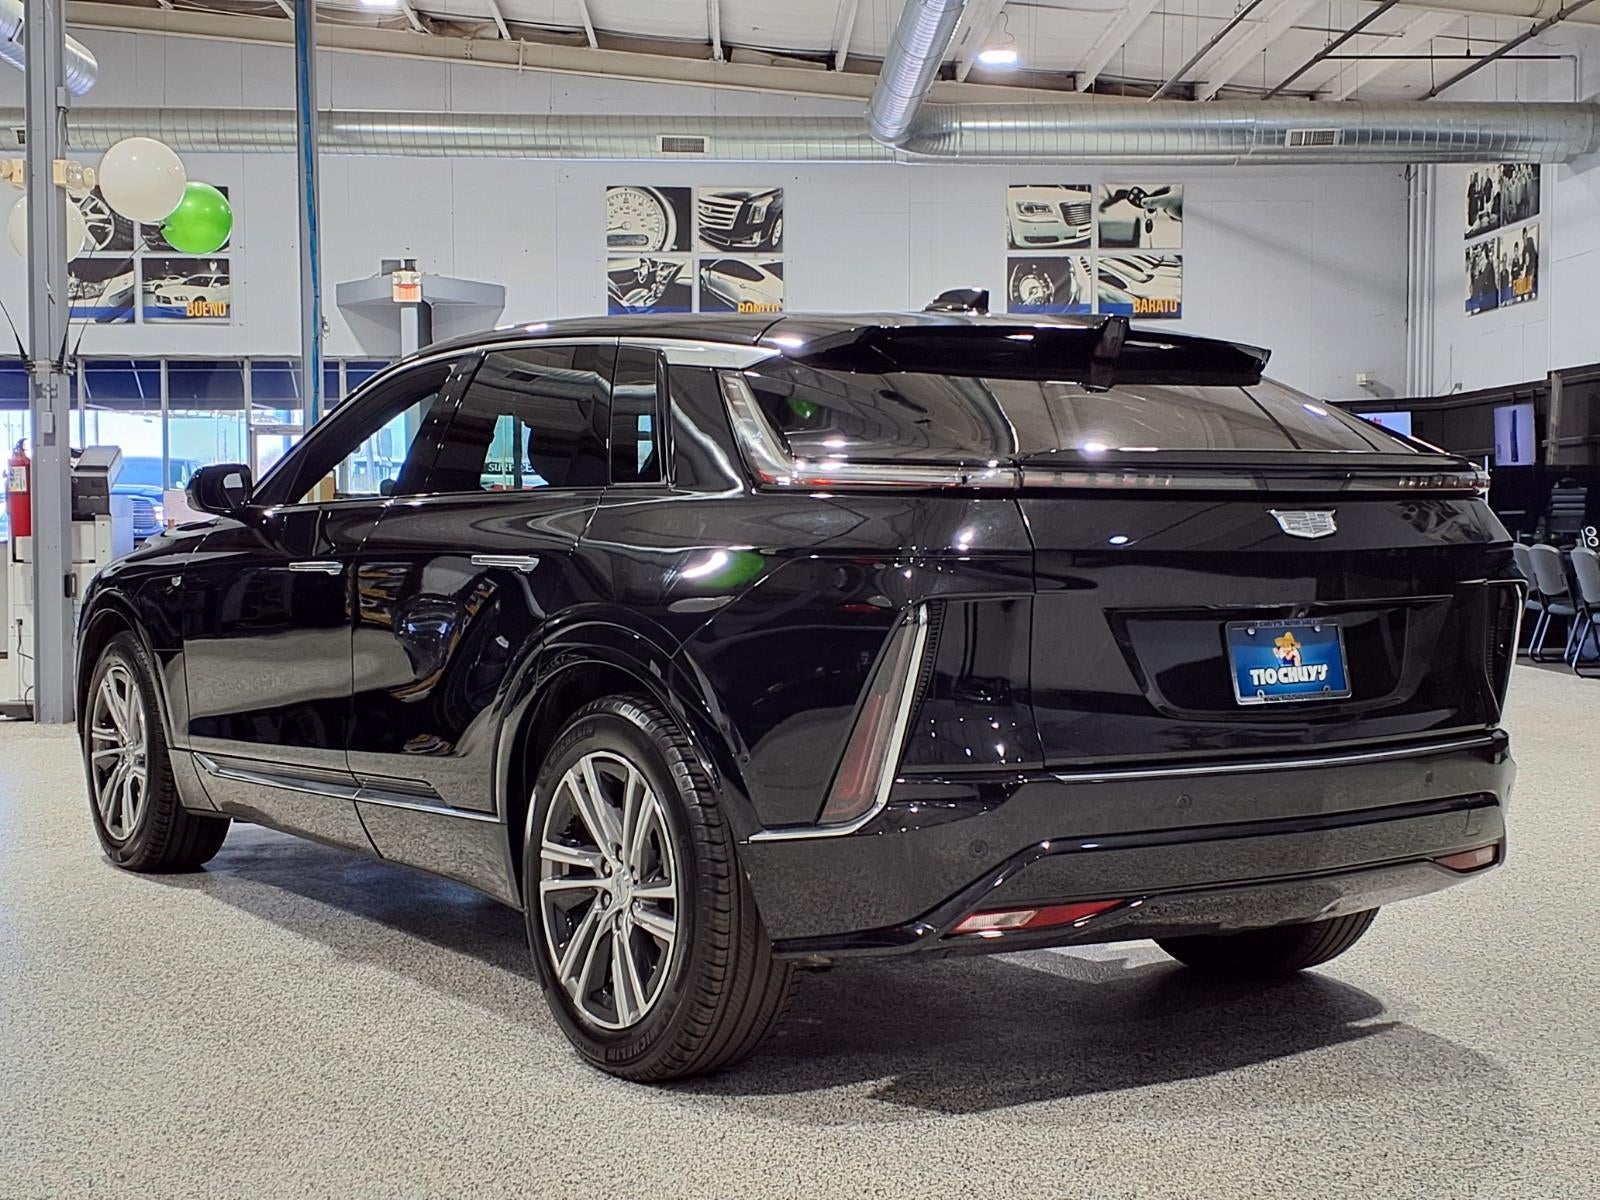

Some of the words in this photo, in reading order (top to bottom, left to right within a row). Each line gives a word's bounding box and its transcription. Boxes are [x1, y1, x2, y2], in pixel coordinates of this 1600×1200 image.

[186, 301, 227, 317] BUENO
[1133, 298, 1178, 313] BARATO
[1250, 668, 1277, 685] TIO
[1278, 664, 1328, 683] CHUY'S
